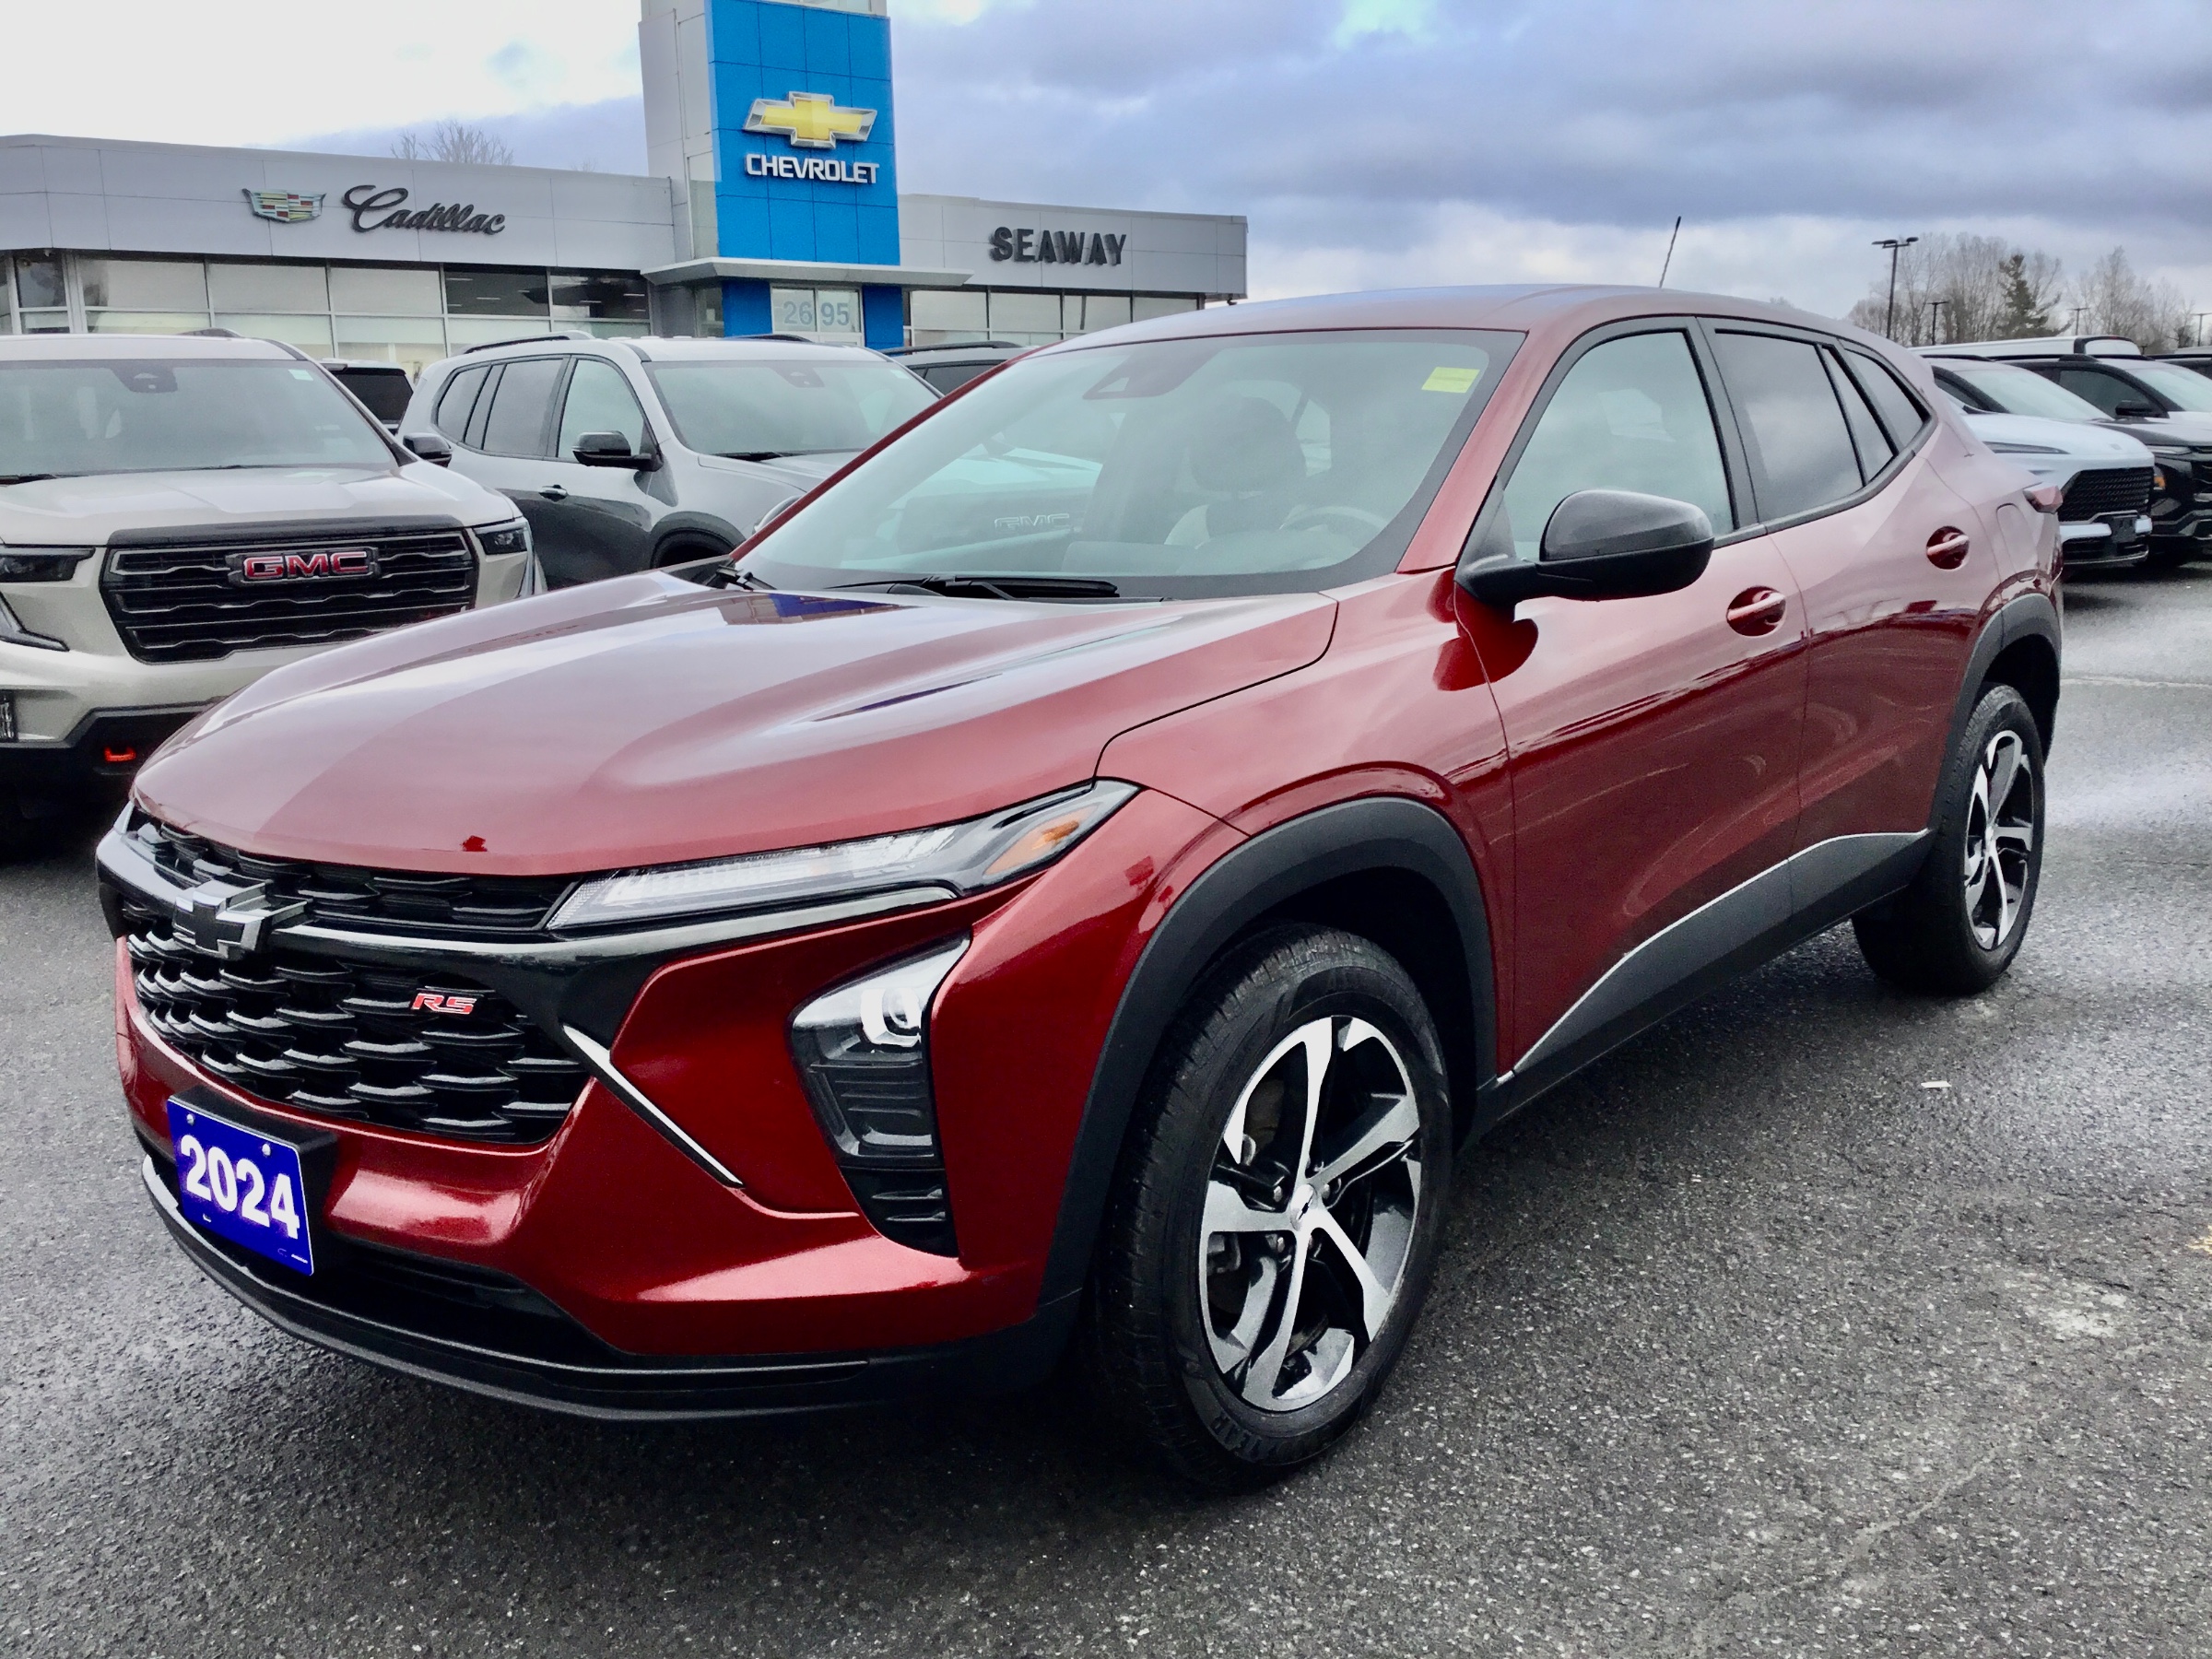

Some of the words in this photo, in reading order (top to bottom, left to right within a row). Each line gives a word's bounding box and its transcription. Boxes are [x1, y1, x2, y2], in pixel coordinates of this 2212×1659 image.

[746, 153, 880, 184] CHEVROLET
[342, 184, 506, 234] Cadillac
[989, 227, 1126, 265] SEAWAY
[243, 551, 369, 580] GMC
[410, 992, 477, 1015] RS
[181, 1135, 300, 1240] 2024
